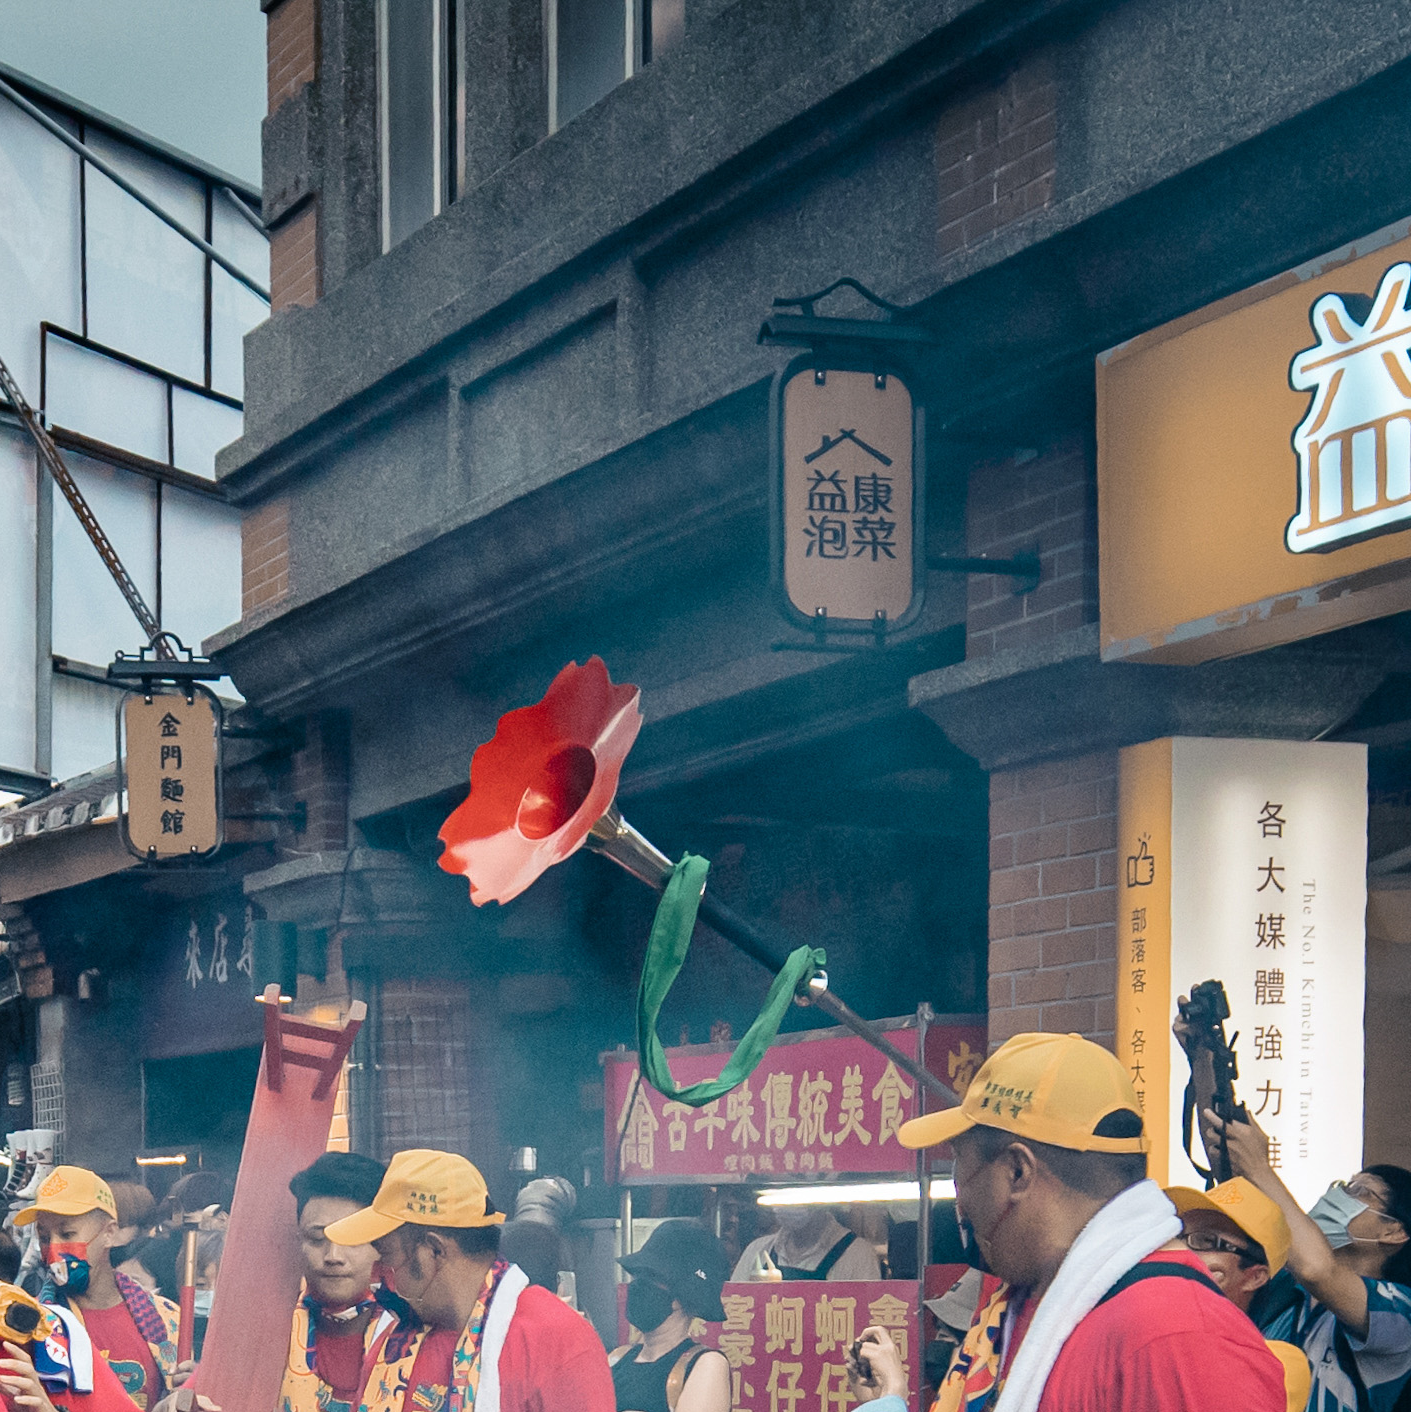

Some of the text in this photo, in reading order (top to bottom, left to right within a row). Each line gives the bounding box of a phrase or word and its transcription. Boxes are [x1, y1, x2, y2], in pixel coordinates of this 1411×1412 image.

[158, 711, 185, 835] 金門麵館
[1298, 879, 1316, 1160] The No.1 Kimchi in Taiwan
